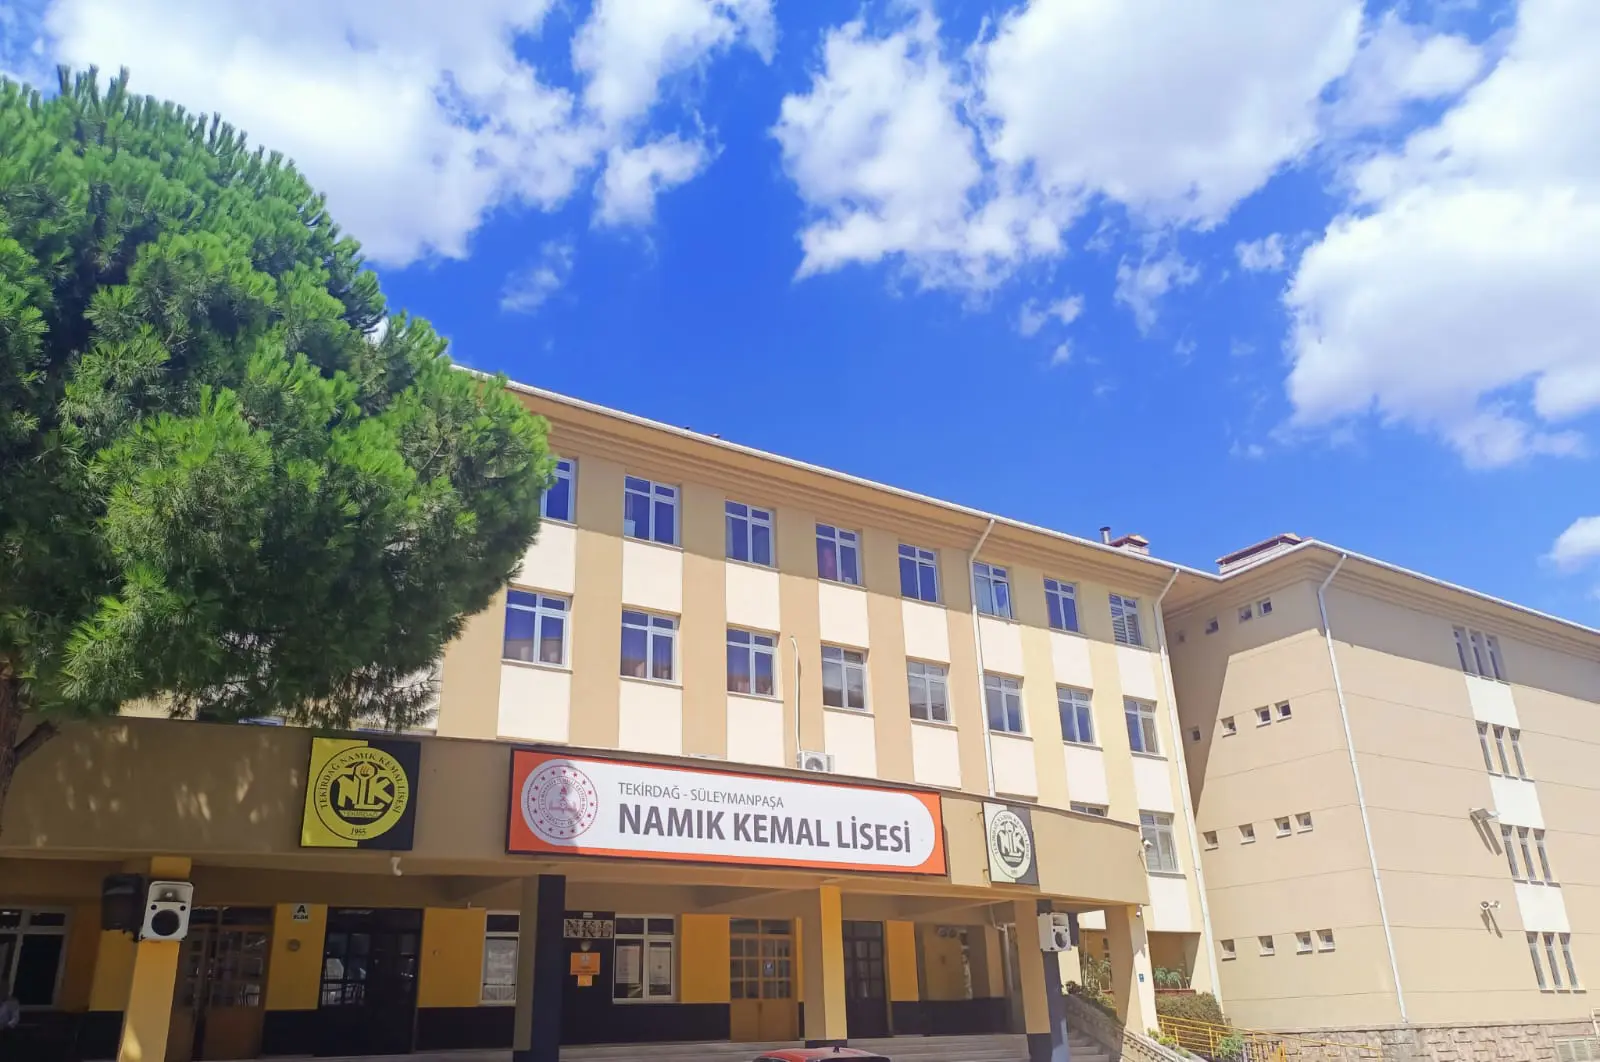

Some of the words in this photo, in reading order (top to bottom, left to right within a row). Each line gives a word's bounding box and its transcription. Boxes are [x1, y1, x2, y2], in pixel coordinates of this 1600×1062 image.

[617, 782, 680, 799] TEKİRDAĞ
[690, 788, 784, 810] SÜLEYMANPAŞA
[618, 803, 726, 840] NAMIK
[733, 812, 830, 848] KEMAL
[837, 815, 911, 853] LİSESİ
[297, 905, 306, 913] A
